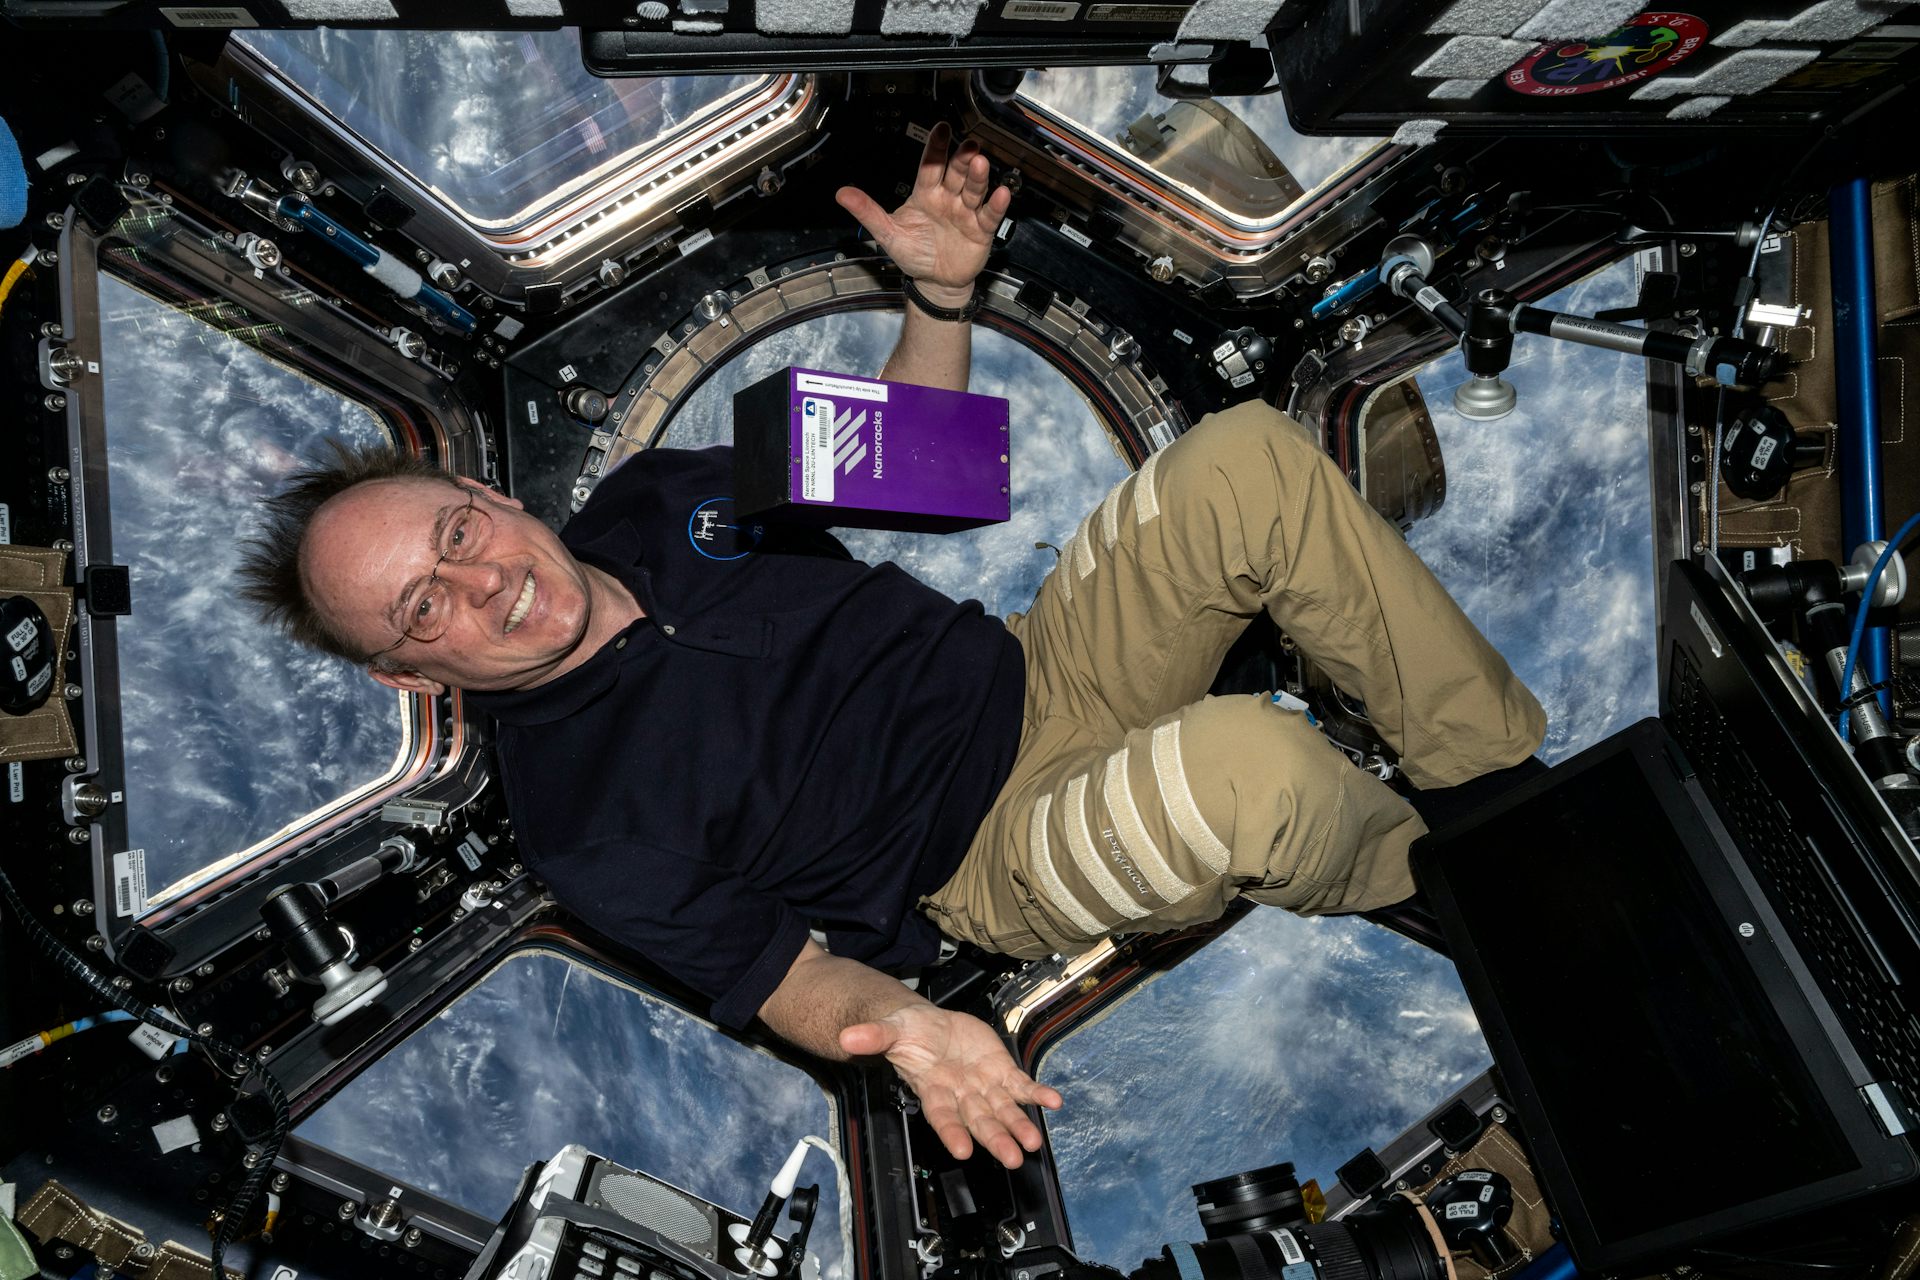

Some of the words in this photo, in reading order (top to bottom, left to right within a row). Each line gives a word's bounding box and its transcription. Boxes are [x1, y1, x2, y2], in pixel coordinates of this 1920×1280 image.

[1667, 36, 1700, 62] BRAD
[1510, 69, 1526, 85] KEN
[1602, 70, 1648, 88] JEFF
[1531, 86, 1579, 95] DAVE
[687, 232, 709, 247] Window
[1556, 319, 1587, 328] BRACKET
[1606, 327, 1641, 340] MULTI-USE
[561, 366, 575, 380] H
[873, 411, 883, 479] Nanoracks
[1762, 442, 1773, 456] FULL
[754, 526, 763, 535] 73
[11, 629, 25, 641] FULL
[22, 621, 29, 630] OP
[27, 626, 34, 635] OP
[18, 669, 24, 679] CL
[1856, 704, 1873, 734] ULTI-USE
[146, 1034, 162, 1047] WINDOW
